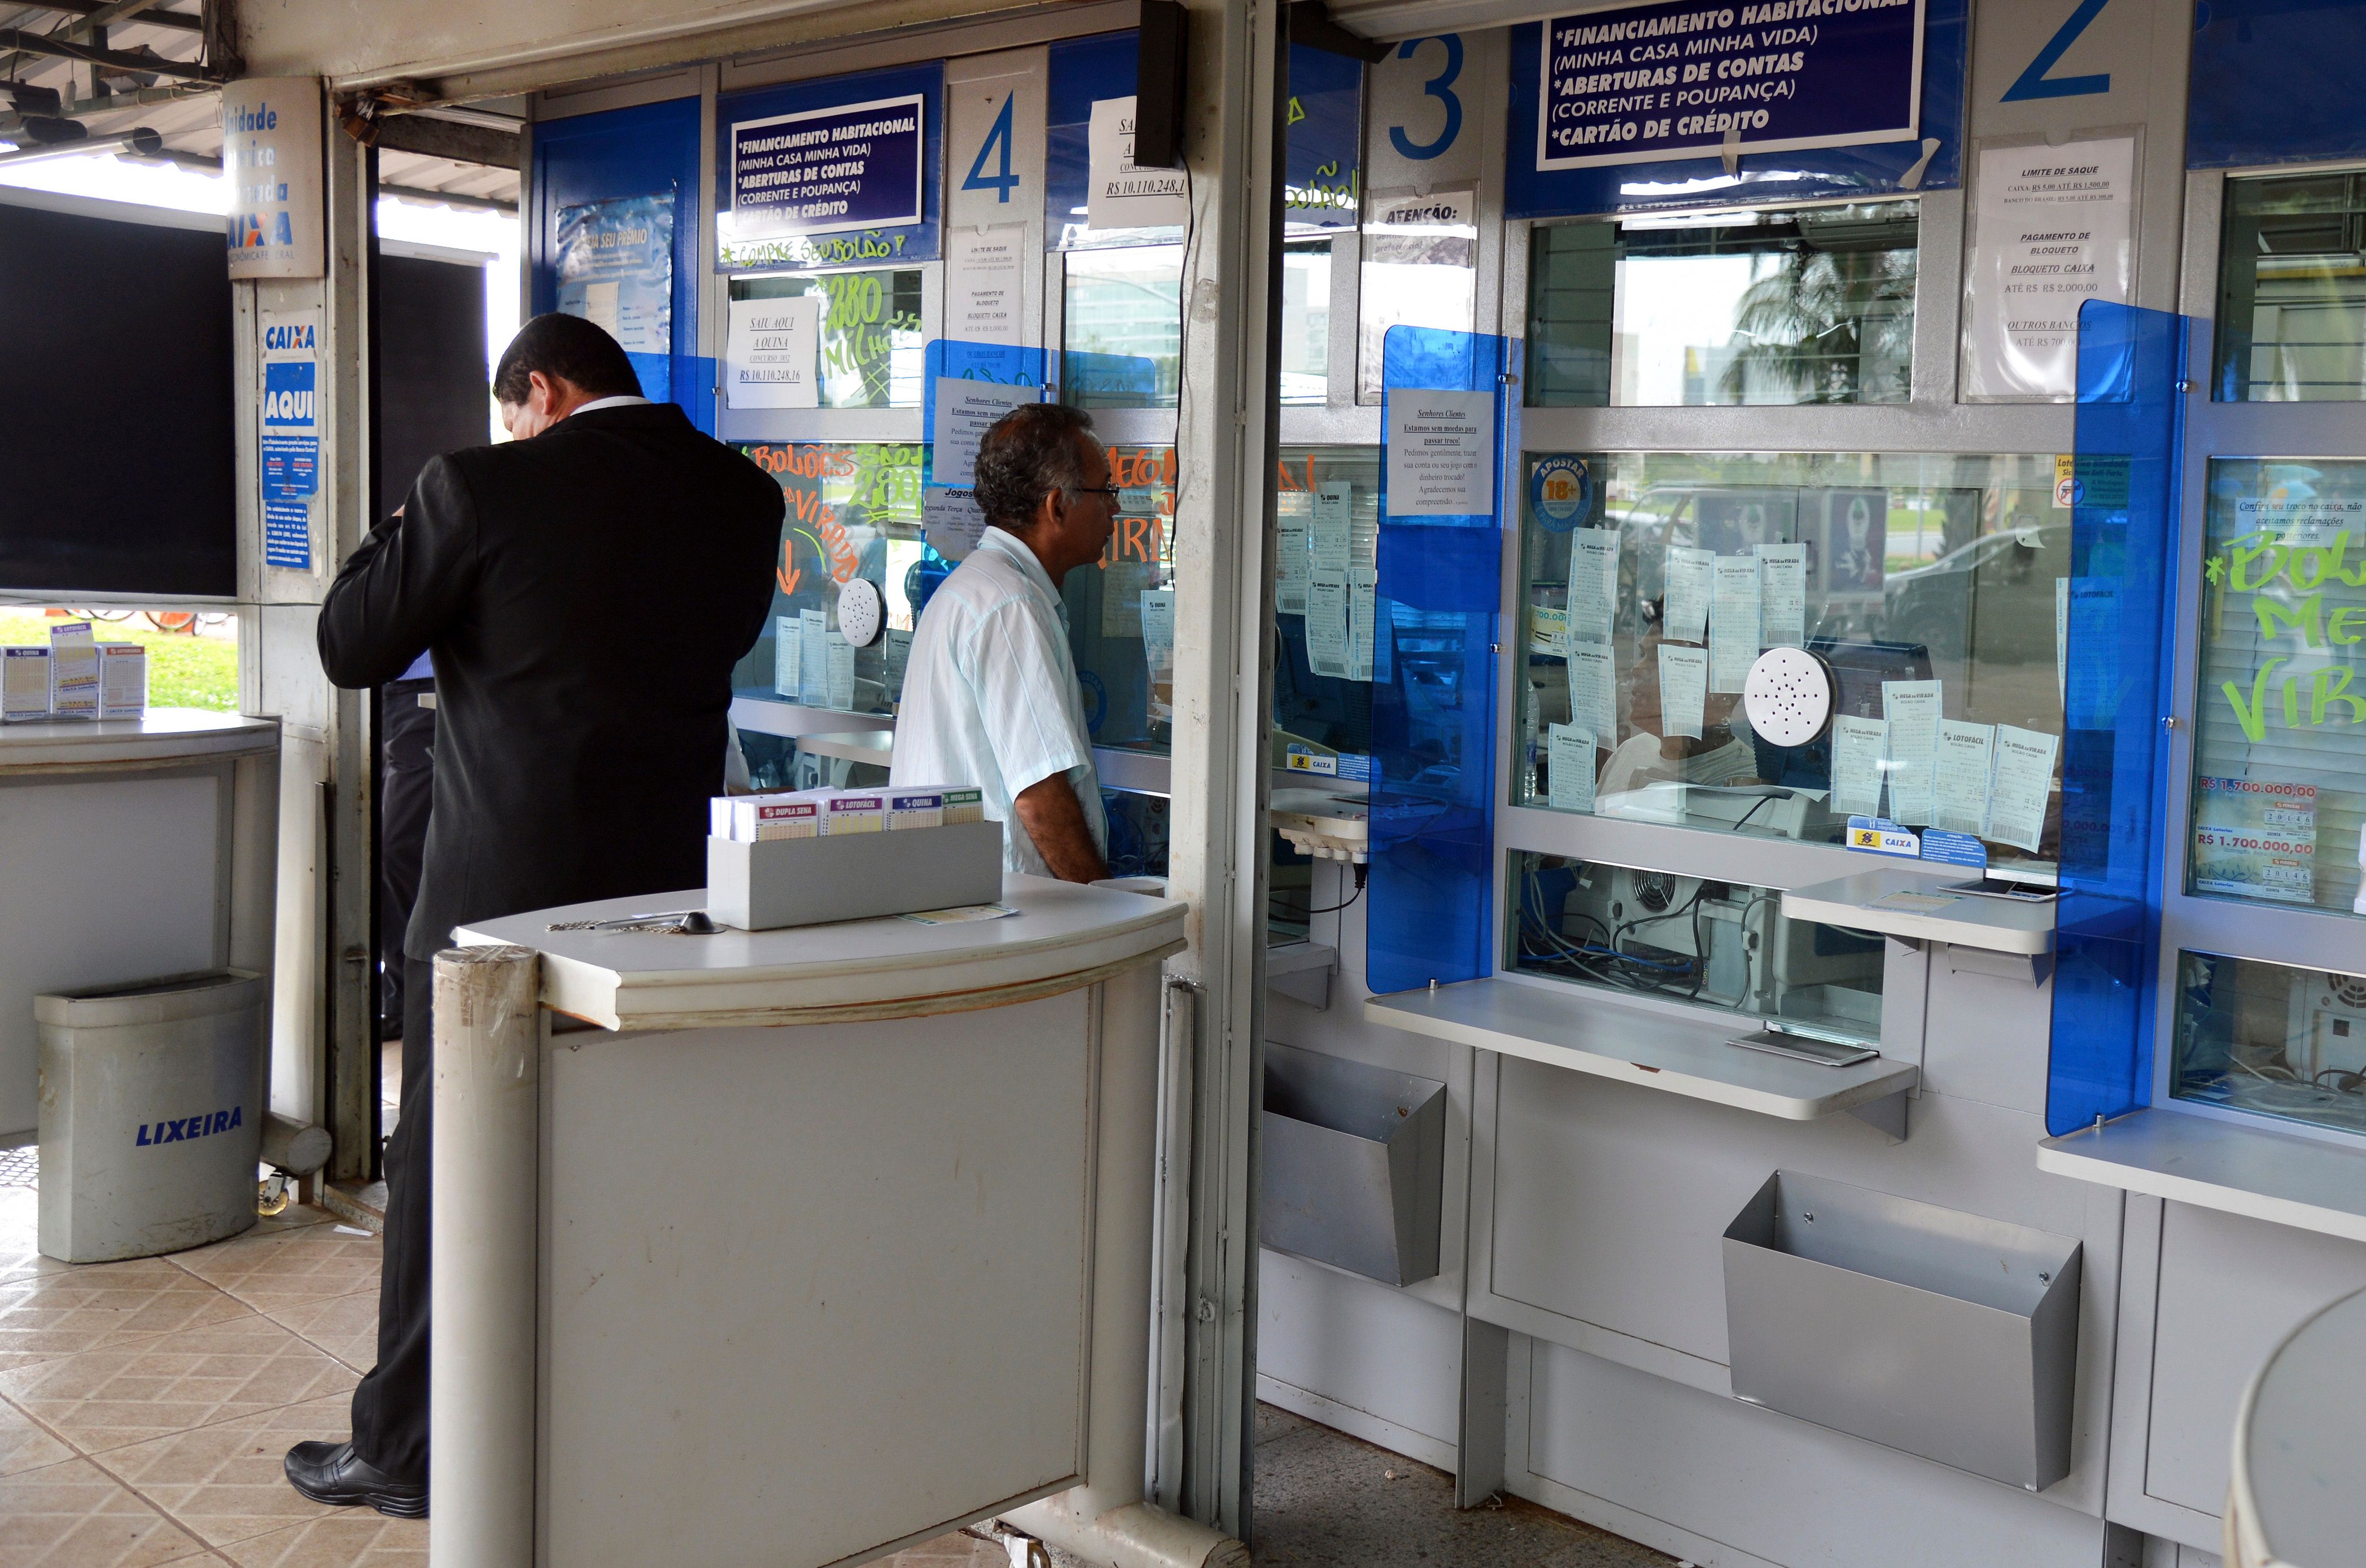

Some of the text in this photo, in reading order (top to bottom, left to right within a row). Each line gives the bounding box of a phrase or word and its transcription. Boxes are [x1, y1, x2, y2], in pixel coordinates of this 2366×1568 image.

[1563, 10, 1734, 47] FINANCIAMENTO
[1555, 25, 1818, 75] (MINHA CASA MINHA VIDA)
[1560, 51, 1805, 96] ABERTURAS DE CONTAS
[1389, 33, 1463, 160] 3
[1552, 79, 1795, 122] (CORRENTE E POUPANÇA)
[1119, 119, 1136, 132] SA
[1559, 109, 1769, 146] CARTÃO DE CRÉDITO
[743, 117, 915, 154] FINANCIAMENTO HABITACIONAL
[961, 89, 1020, 203] 4
[1123, 142, 1131, 155] A
[738, 143, 871, 173] (MINHA CASA MINHA VIDA)
[741, 161, 864, 189] ABERTURAS DE CONTAS
[2022, 169, 2052, 177] LIMITE
[2067, 166, 2098, 174] SAQUE
[2058, 181, 2071, 190] ATÉ
[737, 179, 861, 207] (CORRENTE E POUPANÇA)
[742, 199, 849, 224] CARTÃO DE CRÉDITO
[1386, 203, 1457, 224] ATENÇÃO:
[228, 211, 292, 248] AIXA
[601, 227, 648, 248] SEU PRÊMIO
[2020, 233, 2076, 241] PAGAMENTO
[2011, 264, 2094, 274] BLOQUETO CAIXA
[2005, 283, 2023, 292] ATÉ
[825, 275, 882, 334] 280
[750, 317, 772, 329] SAIU
[2049, 321, 2092, 330] BANCOS
[266, 325, 314, 349] CAIXA
[753, 338, 760, 348] A
[2016, 336, 2035, 347] ATÉ
[265, 391, 313, 420] AQUI
[1450, 462, 1462, 470] jogo
[1541, 459, 1584, 478] APOSTAR
[945, 488, 974, 498] Jogos
[2240, 502, 2269, 511] Confira
[2272, 502, 2284, 511] seu
[2286, 502, 2306, 511] troco
[2320, 502, 2343, 512] caixa,
[2256, 516, 2343, 526] aceitamos reclamações
[2276, 532, 2320, 541] posteriores.
[1953, 734, 1984, 744] LOTOFÁCIL
[2030, 746, 2046, 755] VIRADA
[2202, 778, 2315, 798] R$ 1.700.000,00
[846, 800, 876, 809] LOTOFÁCIL
[912, 798, 933, 807] QUINA
[950, 794, 964, 802] MEGA
[797, 806, 811, 815] SENA
[1885, 839, 1911, 847] CAIXA
[2198, 834, 2214, 846] R$
[2220, 836, 2312, 854] 1.700.000,00
[136, 1106, 242, 1146] LIXEIRA
